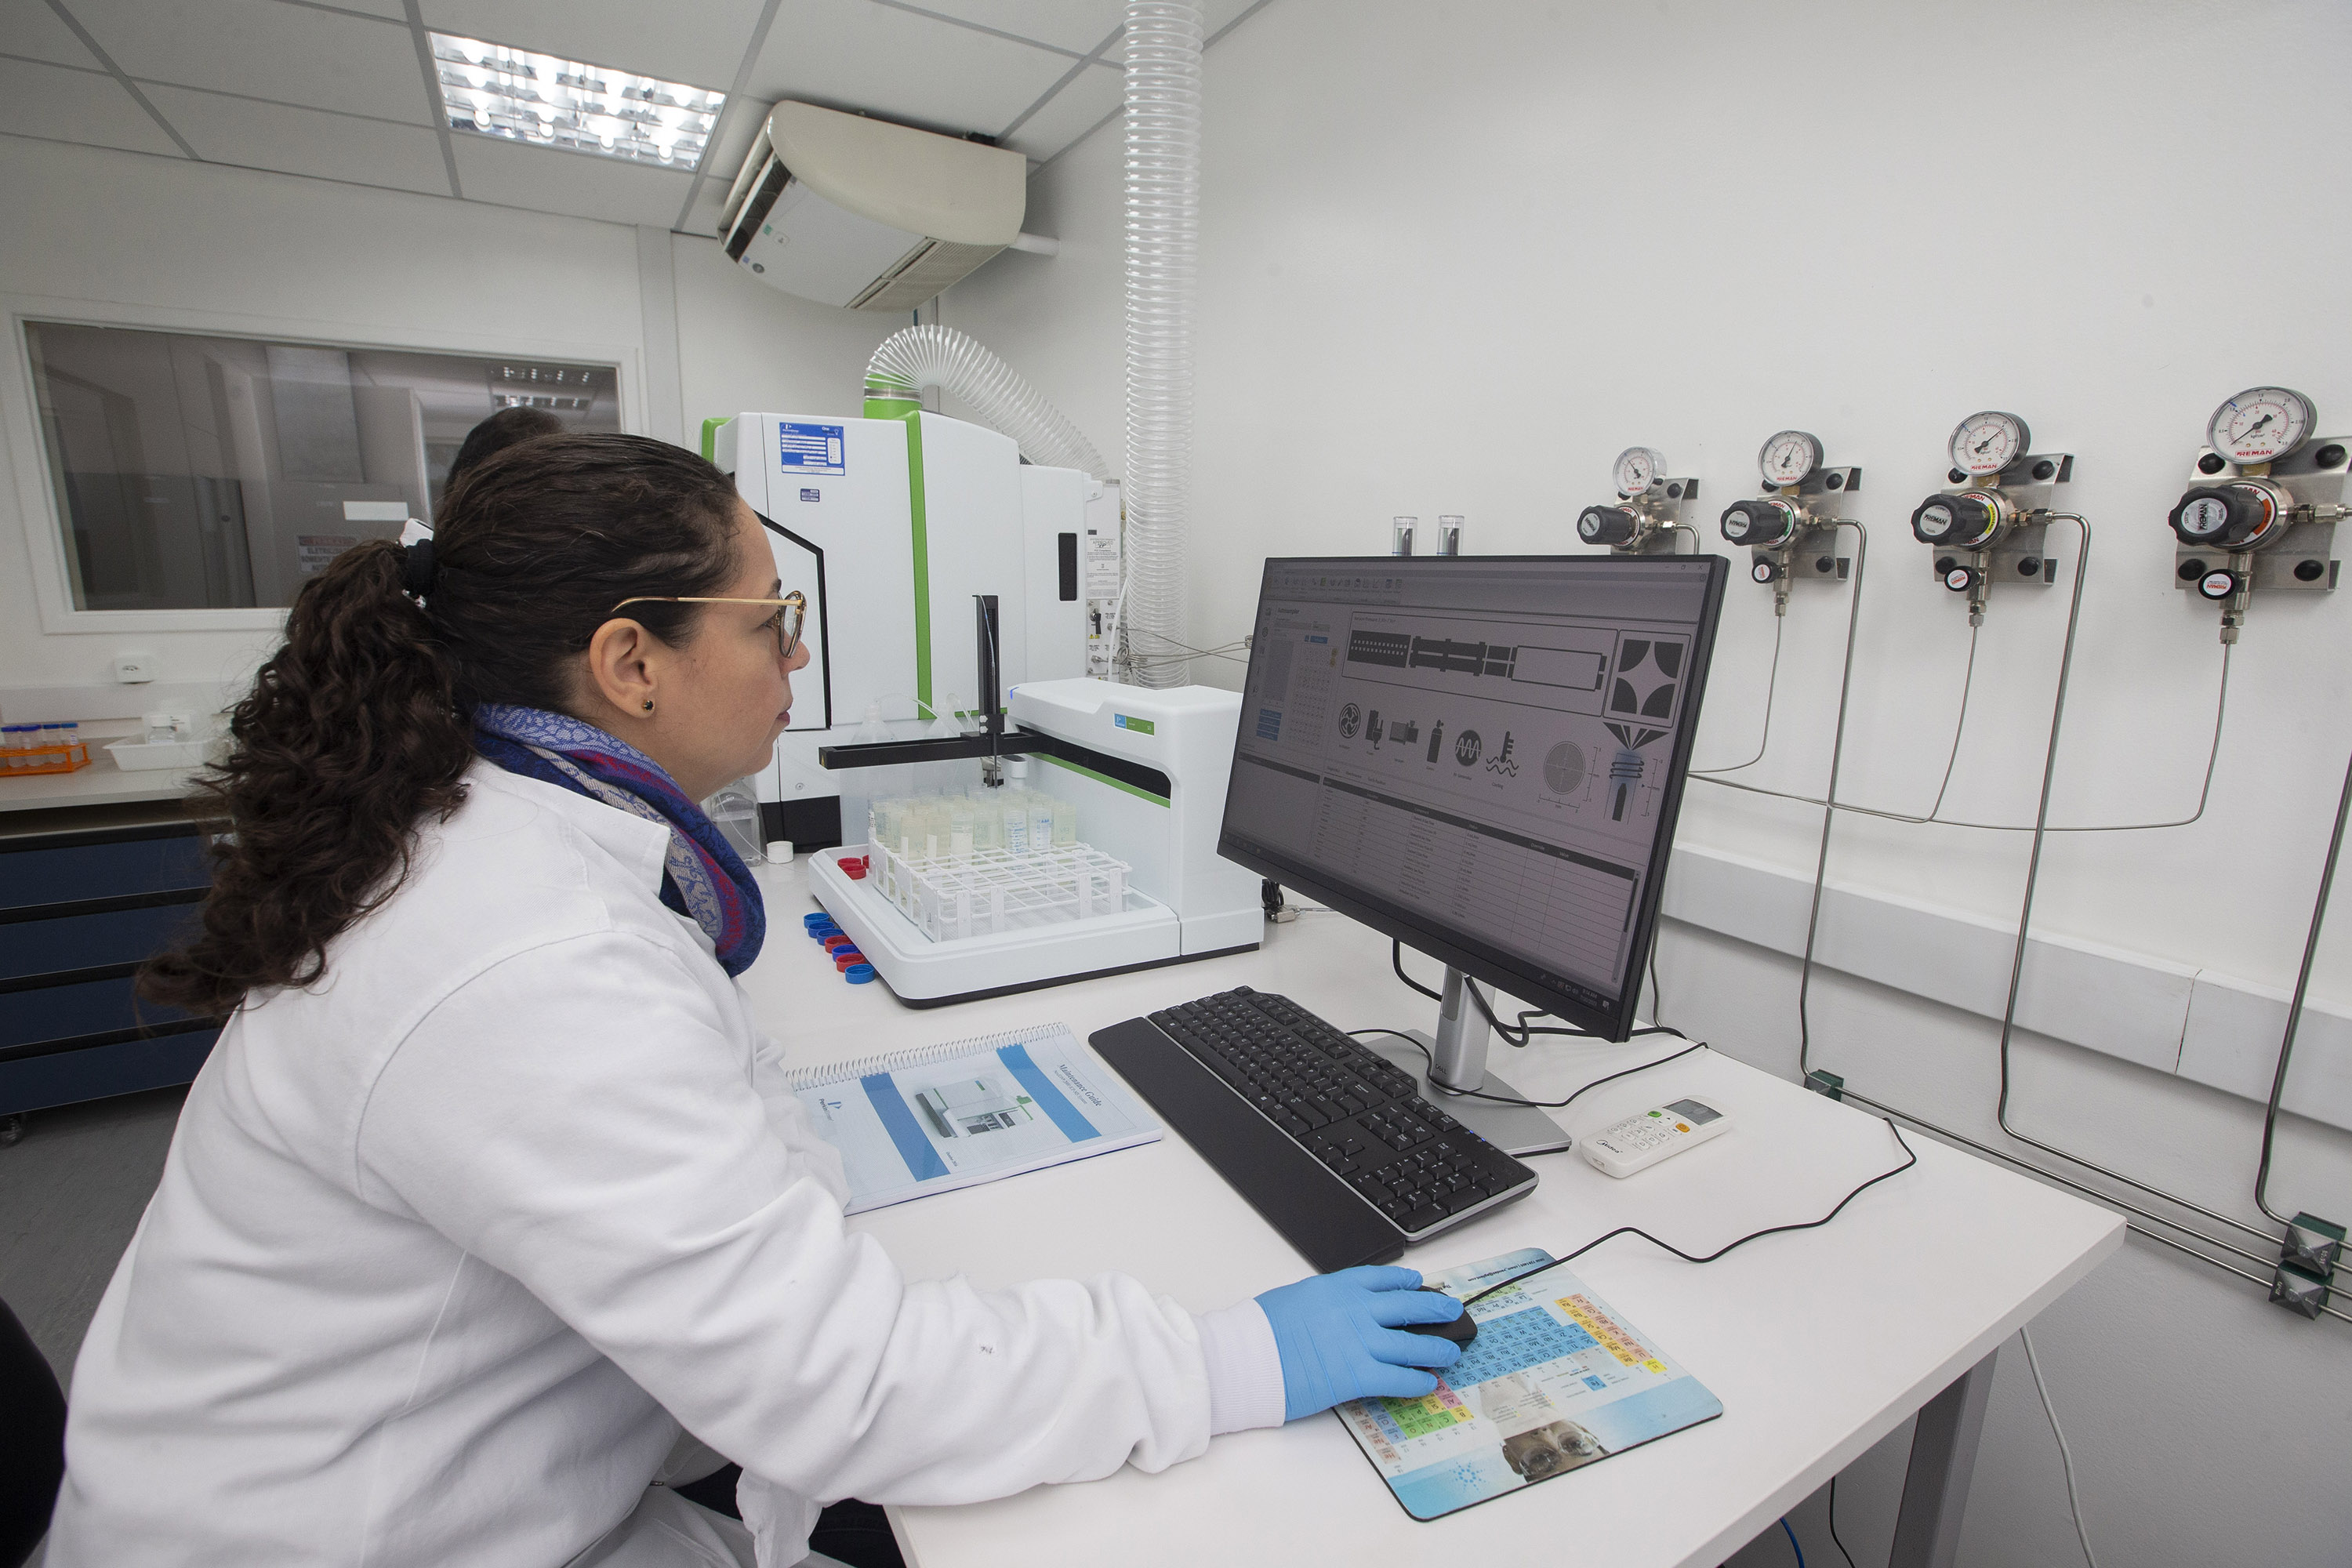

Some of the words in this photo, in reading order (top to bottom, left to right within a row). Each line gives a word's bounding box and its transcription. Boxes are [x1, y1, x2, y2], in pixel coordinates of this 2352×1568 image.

[1059, 1064, 1087, 1091] Maintenance
[1085, 1091, 1102, 1106] Guide
[1596, 1140, 1619, 1153] Midea
